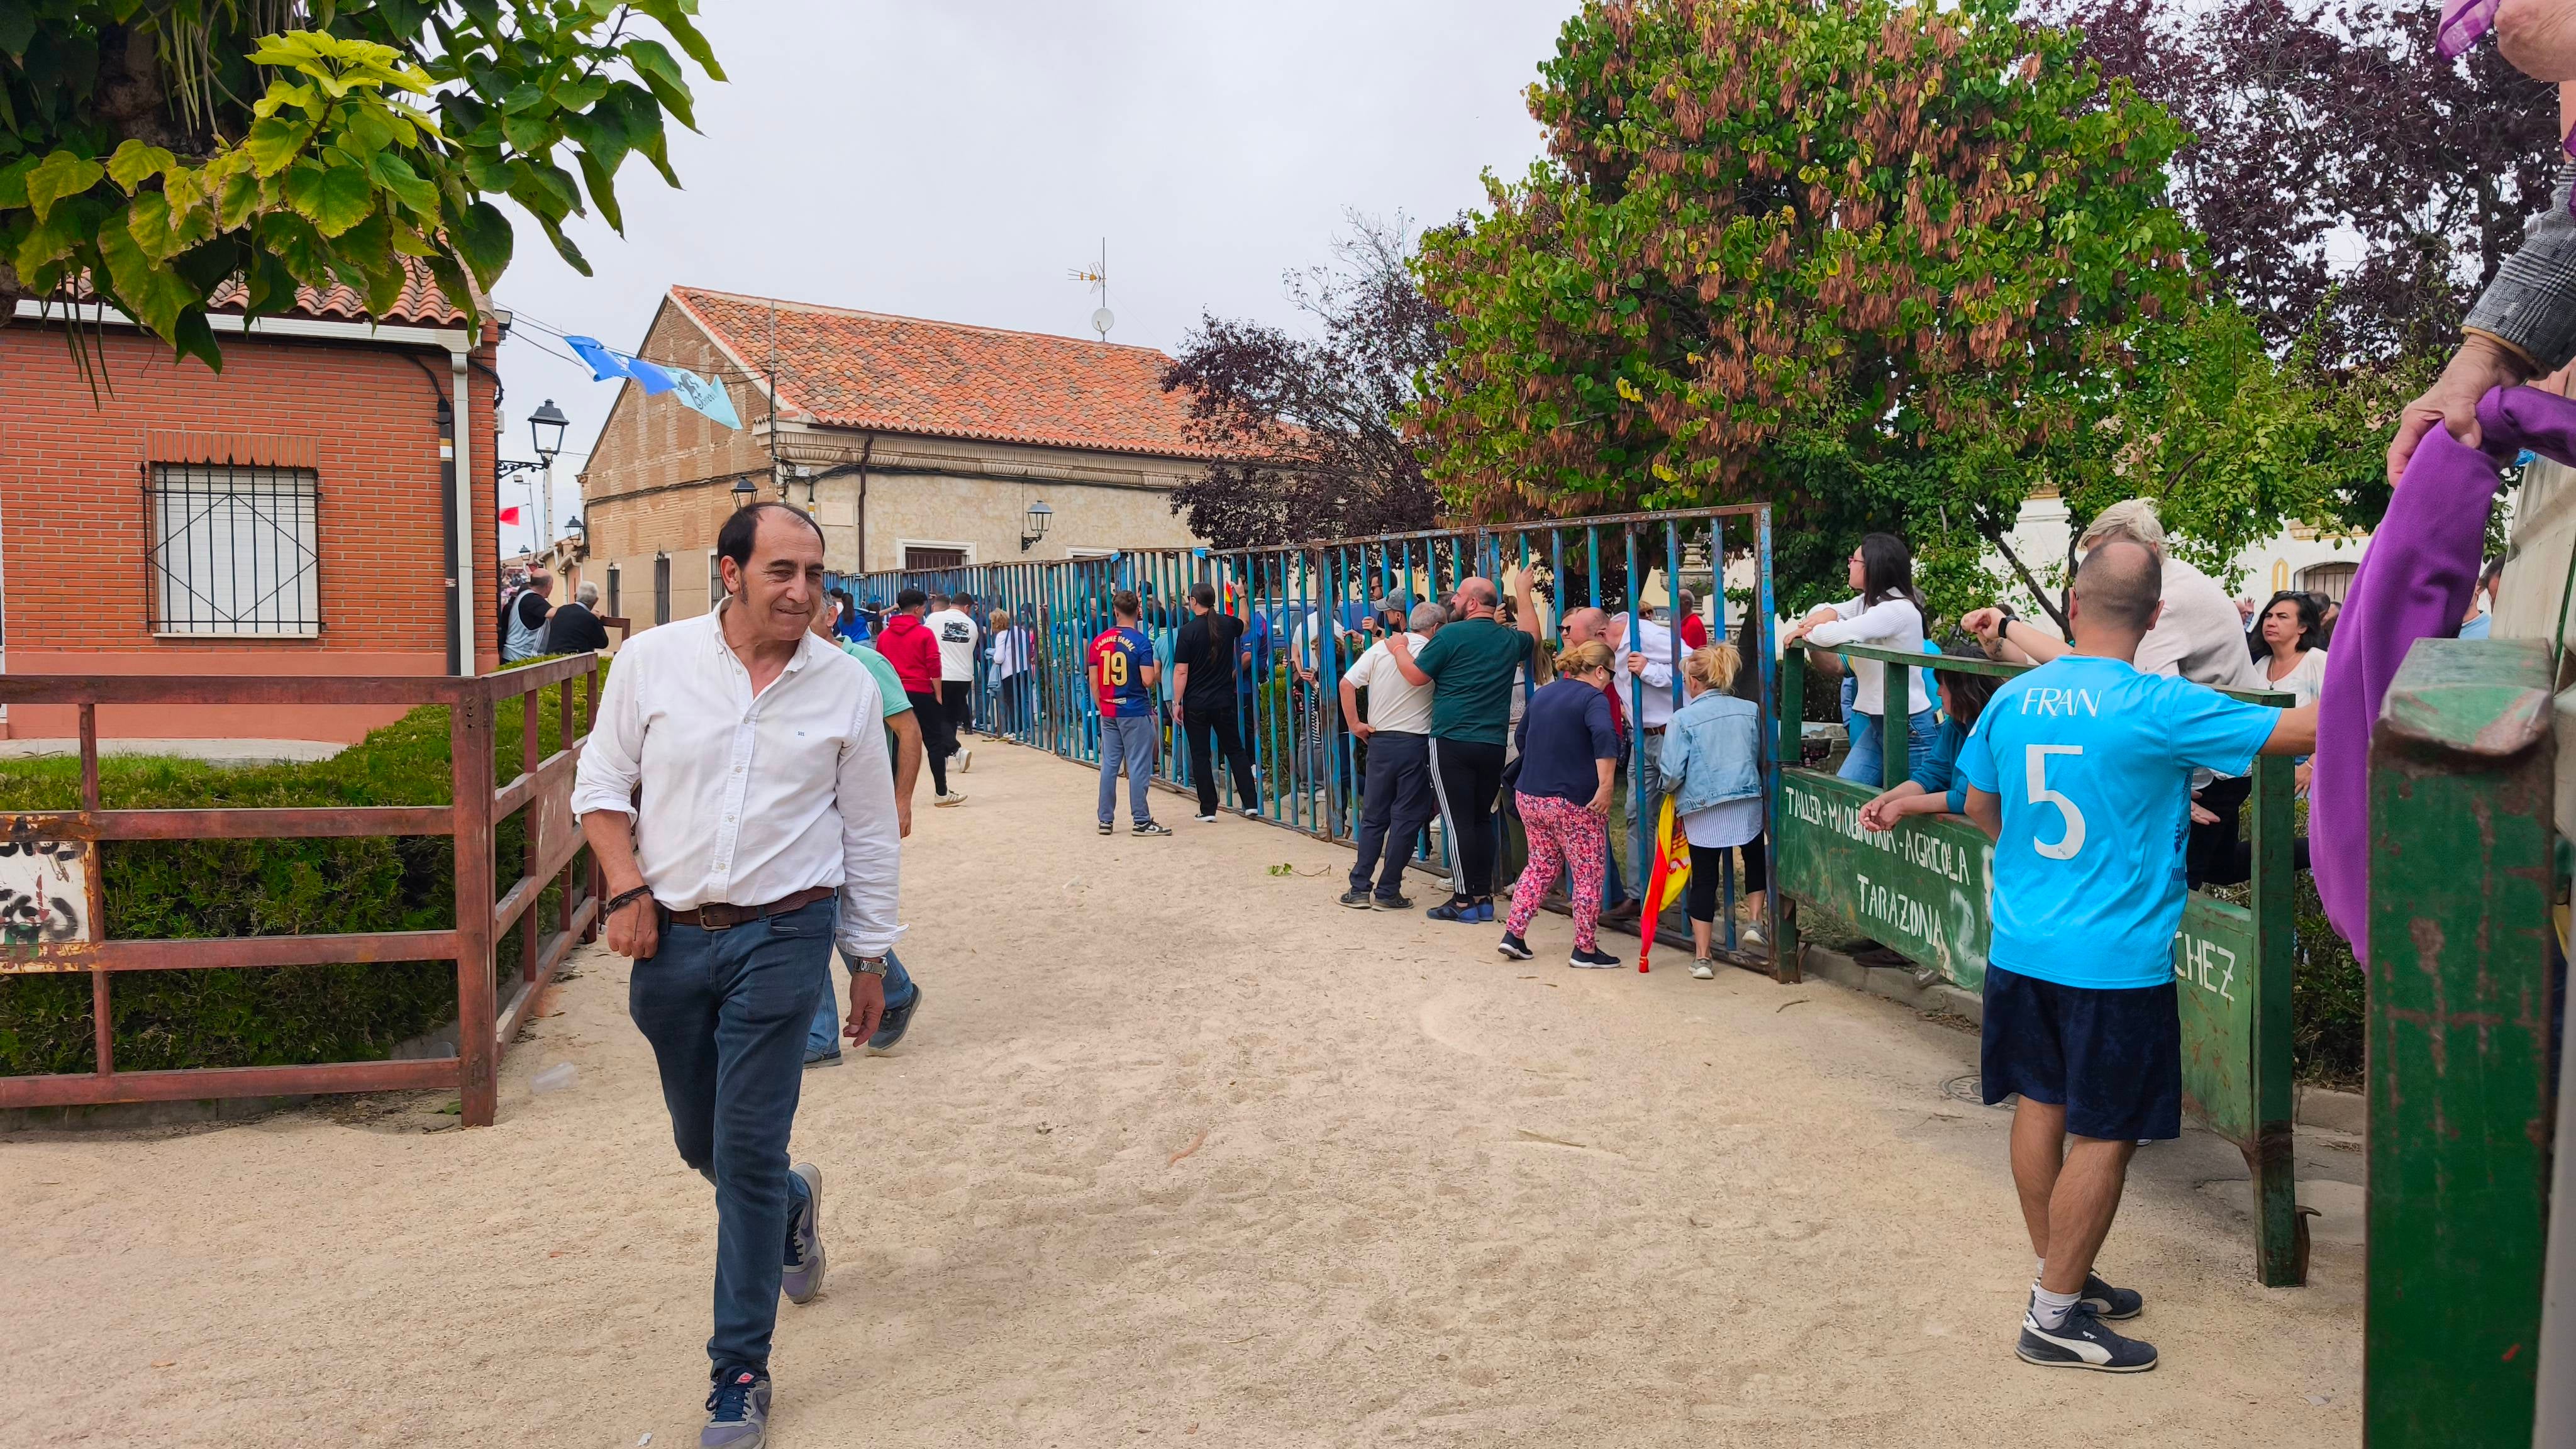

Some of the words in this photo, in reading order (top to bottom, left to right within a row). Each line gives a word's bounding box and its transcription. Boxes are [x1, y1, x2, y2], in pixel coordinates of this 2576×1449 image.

[1095, 635, 1117, 650] LAMINE
[1118, 635, 1136, 652] YAMAL
[1100, 650, 1128, 686] 19
[2021, 687, 2102, 718] FRAN
[2026, 744, 2086, 860] 5
[1857, 873, 1948, 951] TARAZONA
